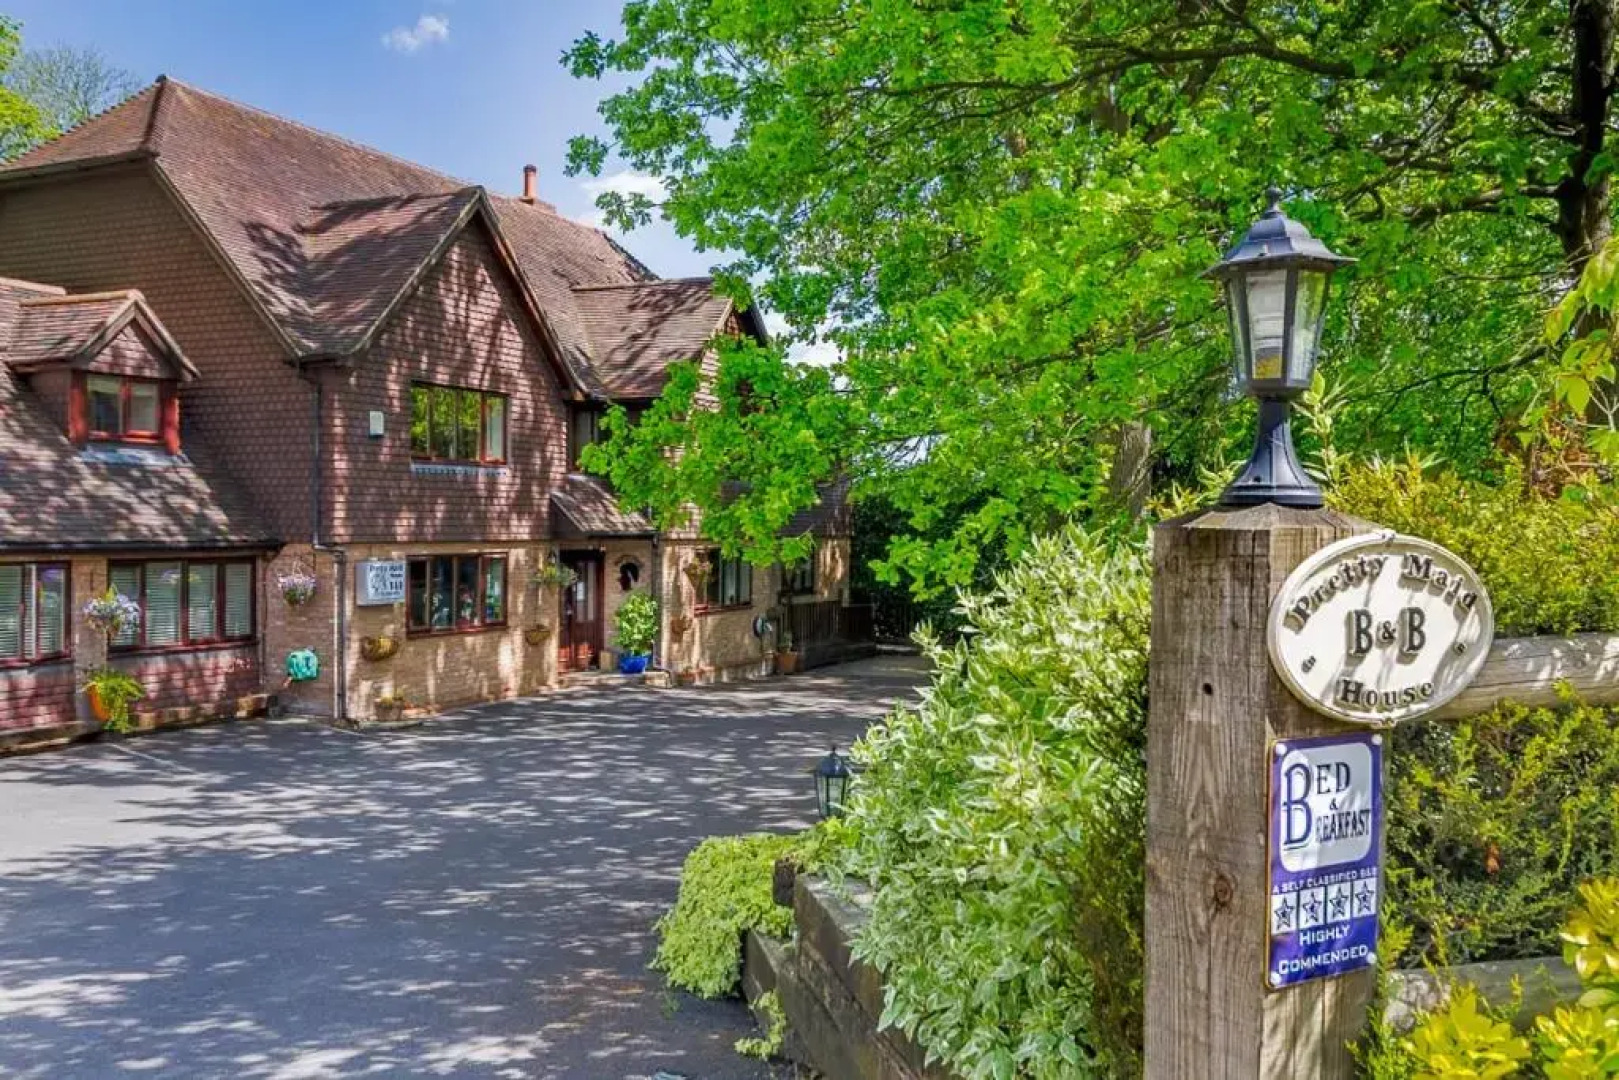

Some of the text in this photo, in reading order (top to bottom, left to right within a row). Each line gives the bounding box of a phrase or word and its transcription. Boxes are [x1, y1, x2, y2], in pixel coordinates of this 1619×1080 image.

[1292, 554, 1477, 622] Pretty Maid
[1341, 679, 1433, 706] House
[1278, 943, 1369, 975] COMMENDED
